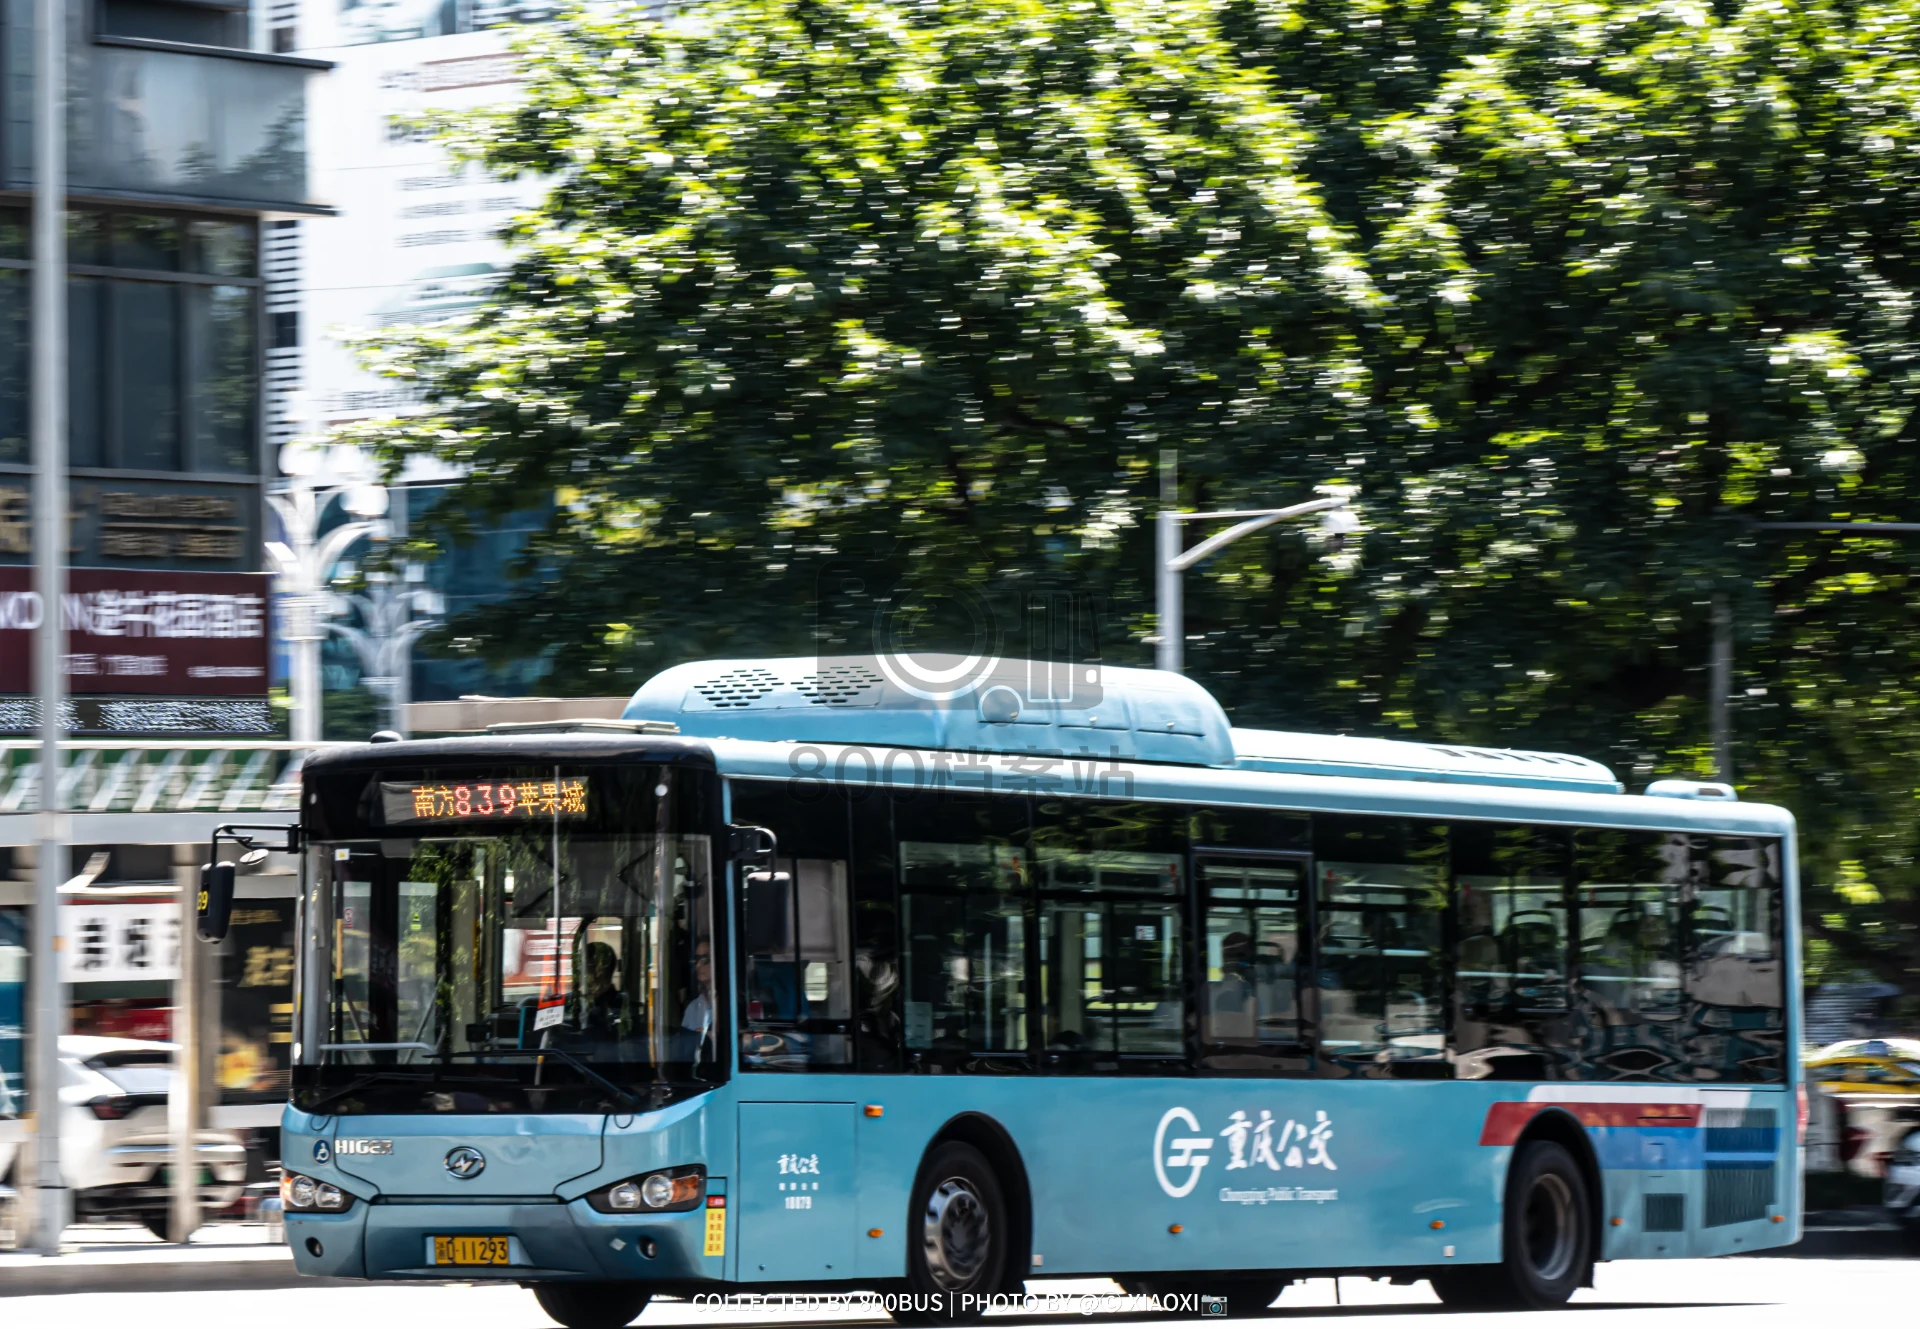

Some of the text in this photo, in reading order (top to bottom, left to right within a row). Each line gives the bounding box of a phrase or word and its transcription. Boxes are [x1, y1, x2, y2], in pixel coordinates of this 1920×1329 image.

[335, 1139, 393, 1155] HIGER
[1219, 1110, 1337, 1171] 重庆公交
